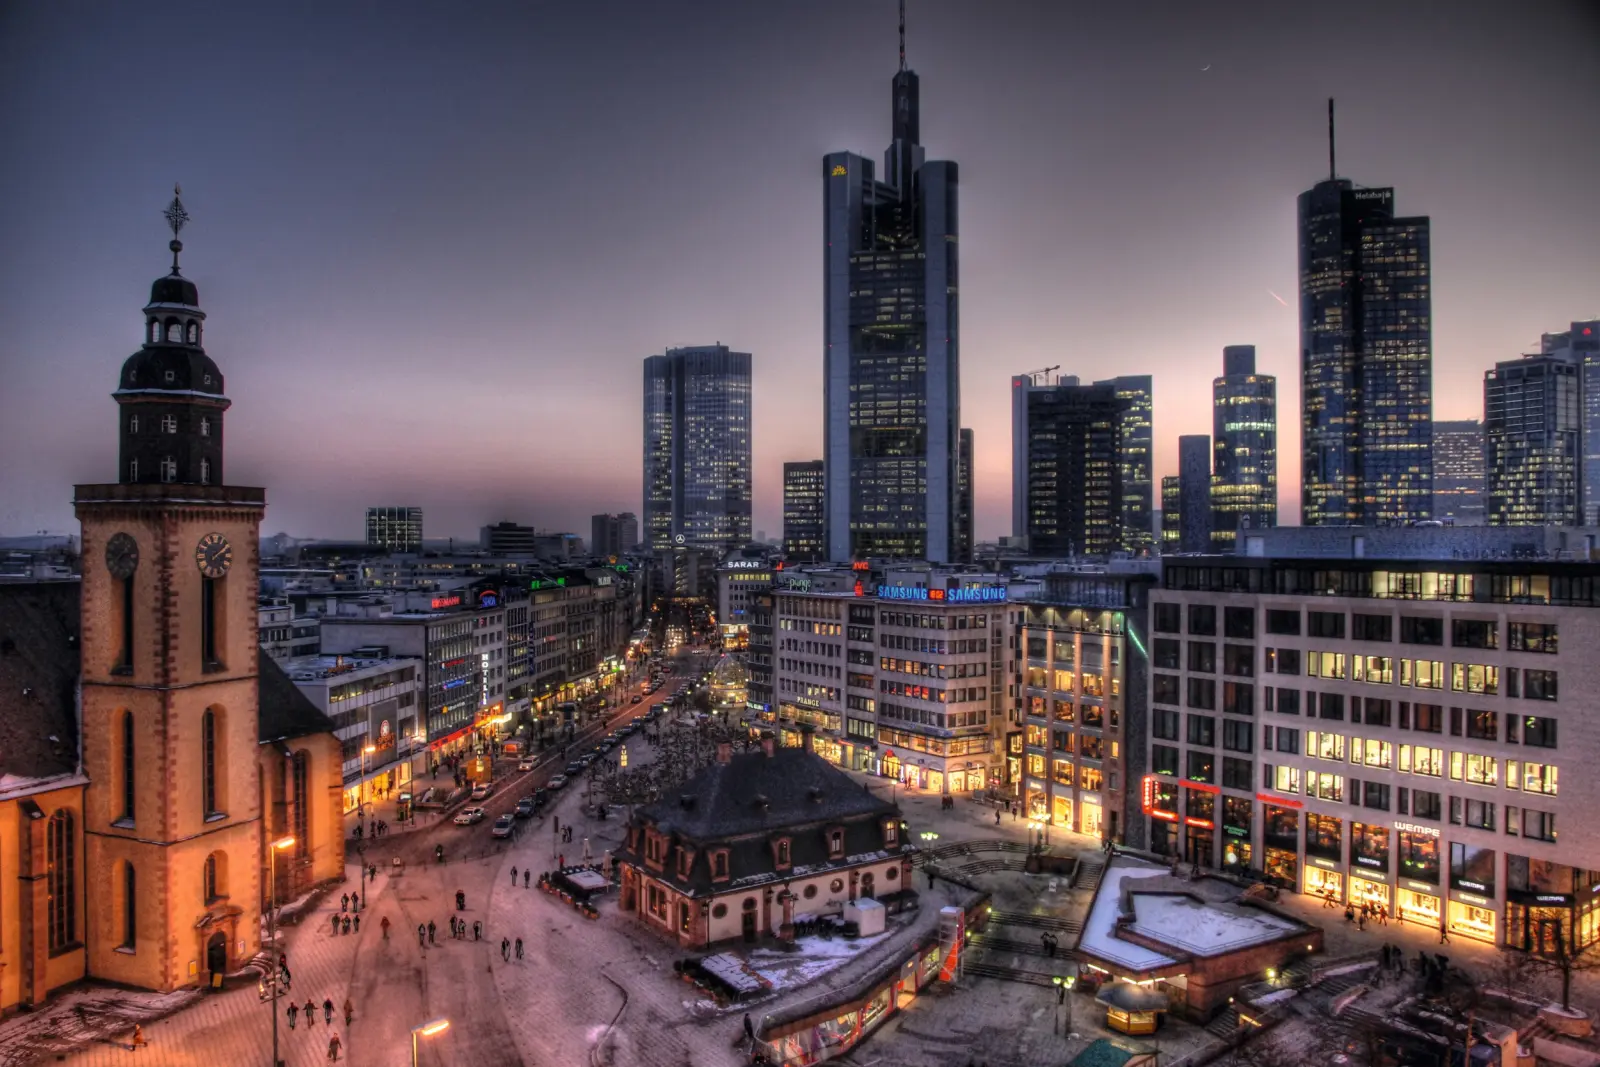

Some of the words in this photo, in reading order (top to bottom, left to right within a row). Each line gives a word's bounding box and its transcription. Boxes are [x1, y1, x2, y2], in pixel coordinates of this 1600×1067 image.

[727, 561, 760, 569] SARAR
[878, 585, 927, 600] SAMSUNG
[948, 586, 1005, 601] SAMSUNG
[797, 696, 820, 708] PRANGE
[1394, 821, 1441, 838] WEMPE
